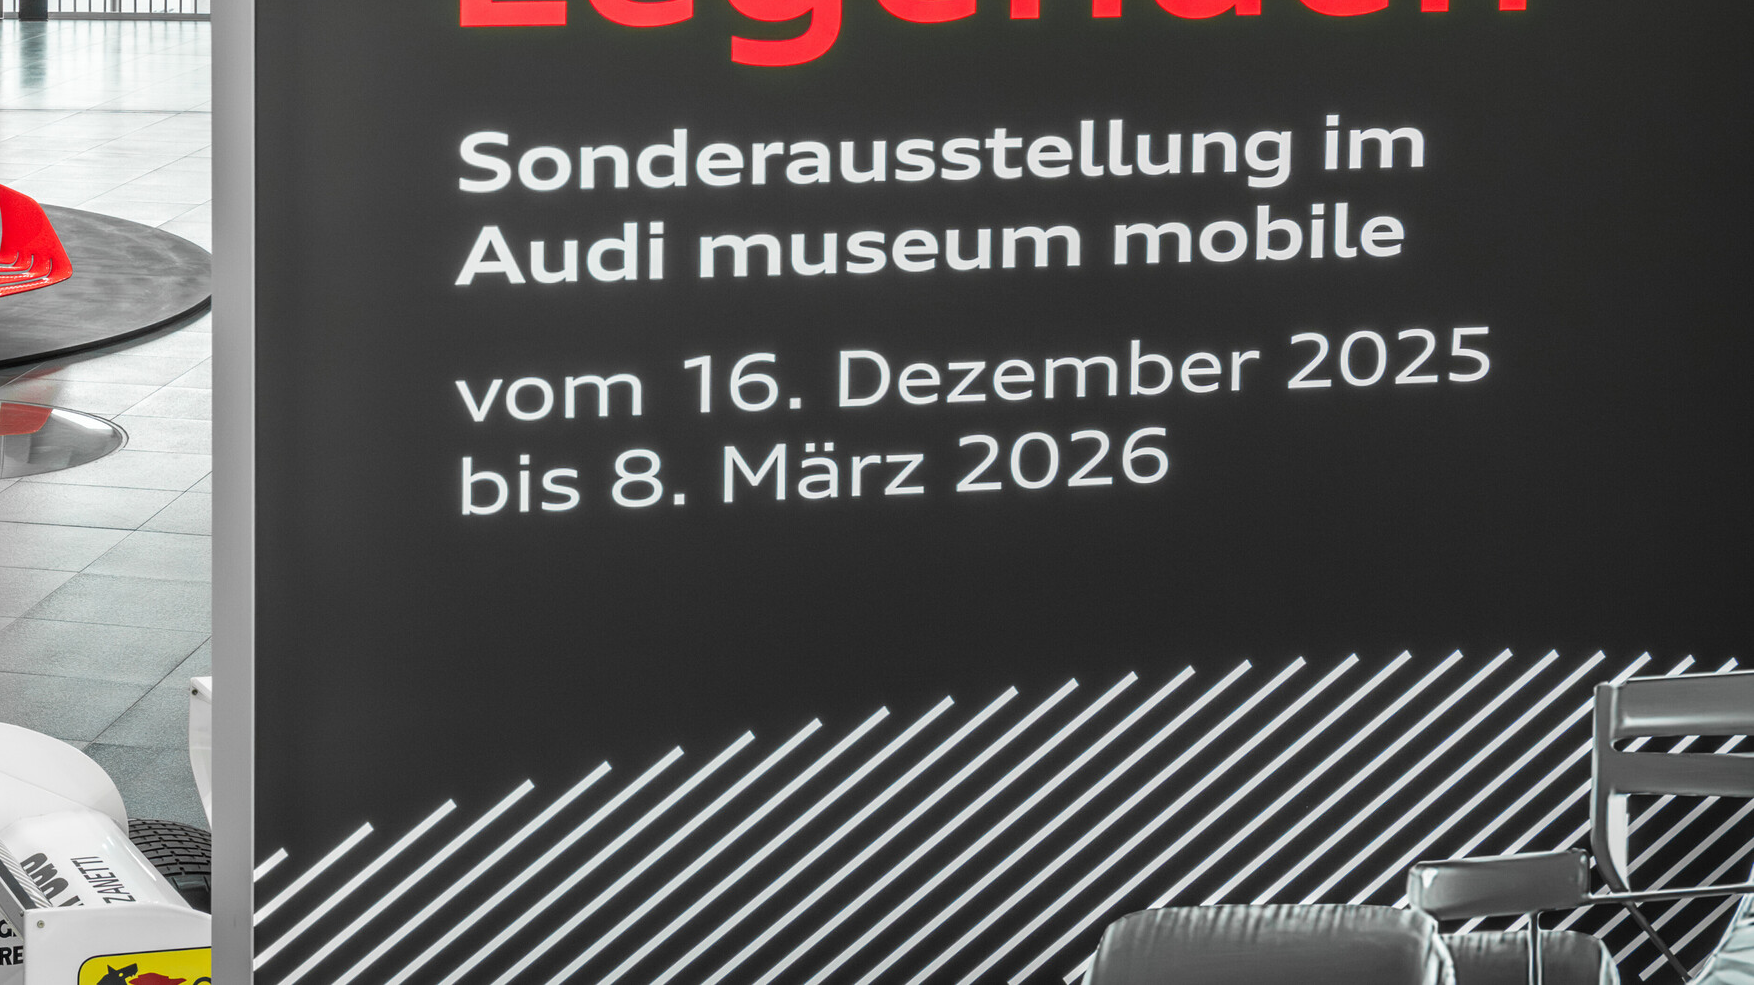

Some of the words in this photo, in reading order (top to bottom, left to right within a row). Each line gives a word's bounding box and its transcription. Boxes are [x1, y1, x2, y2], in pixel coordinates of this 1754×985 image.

[459, 119, 1292, 193] Sonderausstellung
[1325, 115, 1425, 171] im
[455, 221, 665, 286] Audi
[700, 226, 1081, 279] museum
[1114, 205, 1405, 265] mobile
[455, 374, 643, 423] vom
[684, 353, 802, 414] 16.
[839, 340, 1261, 408] Dezember
[1288, 327, 1491, 390] 2025
[462, 454, 581, 515] bis
[612, 449, 686, 508] 8.
[724, 442, 925, 504] März
[957, 427, 1169, 493] 2026
[70, 856, 137, 904] ZANETTI
